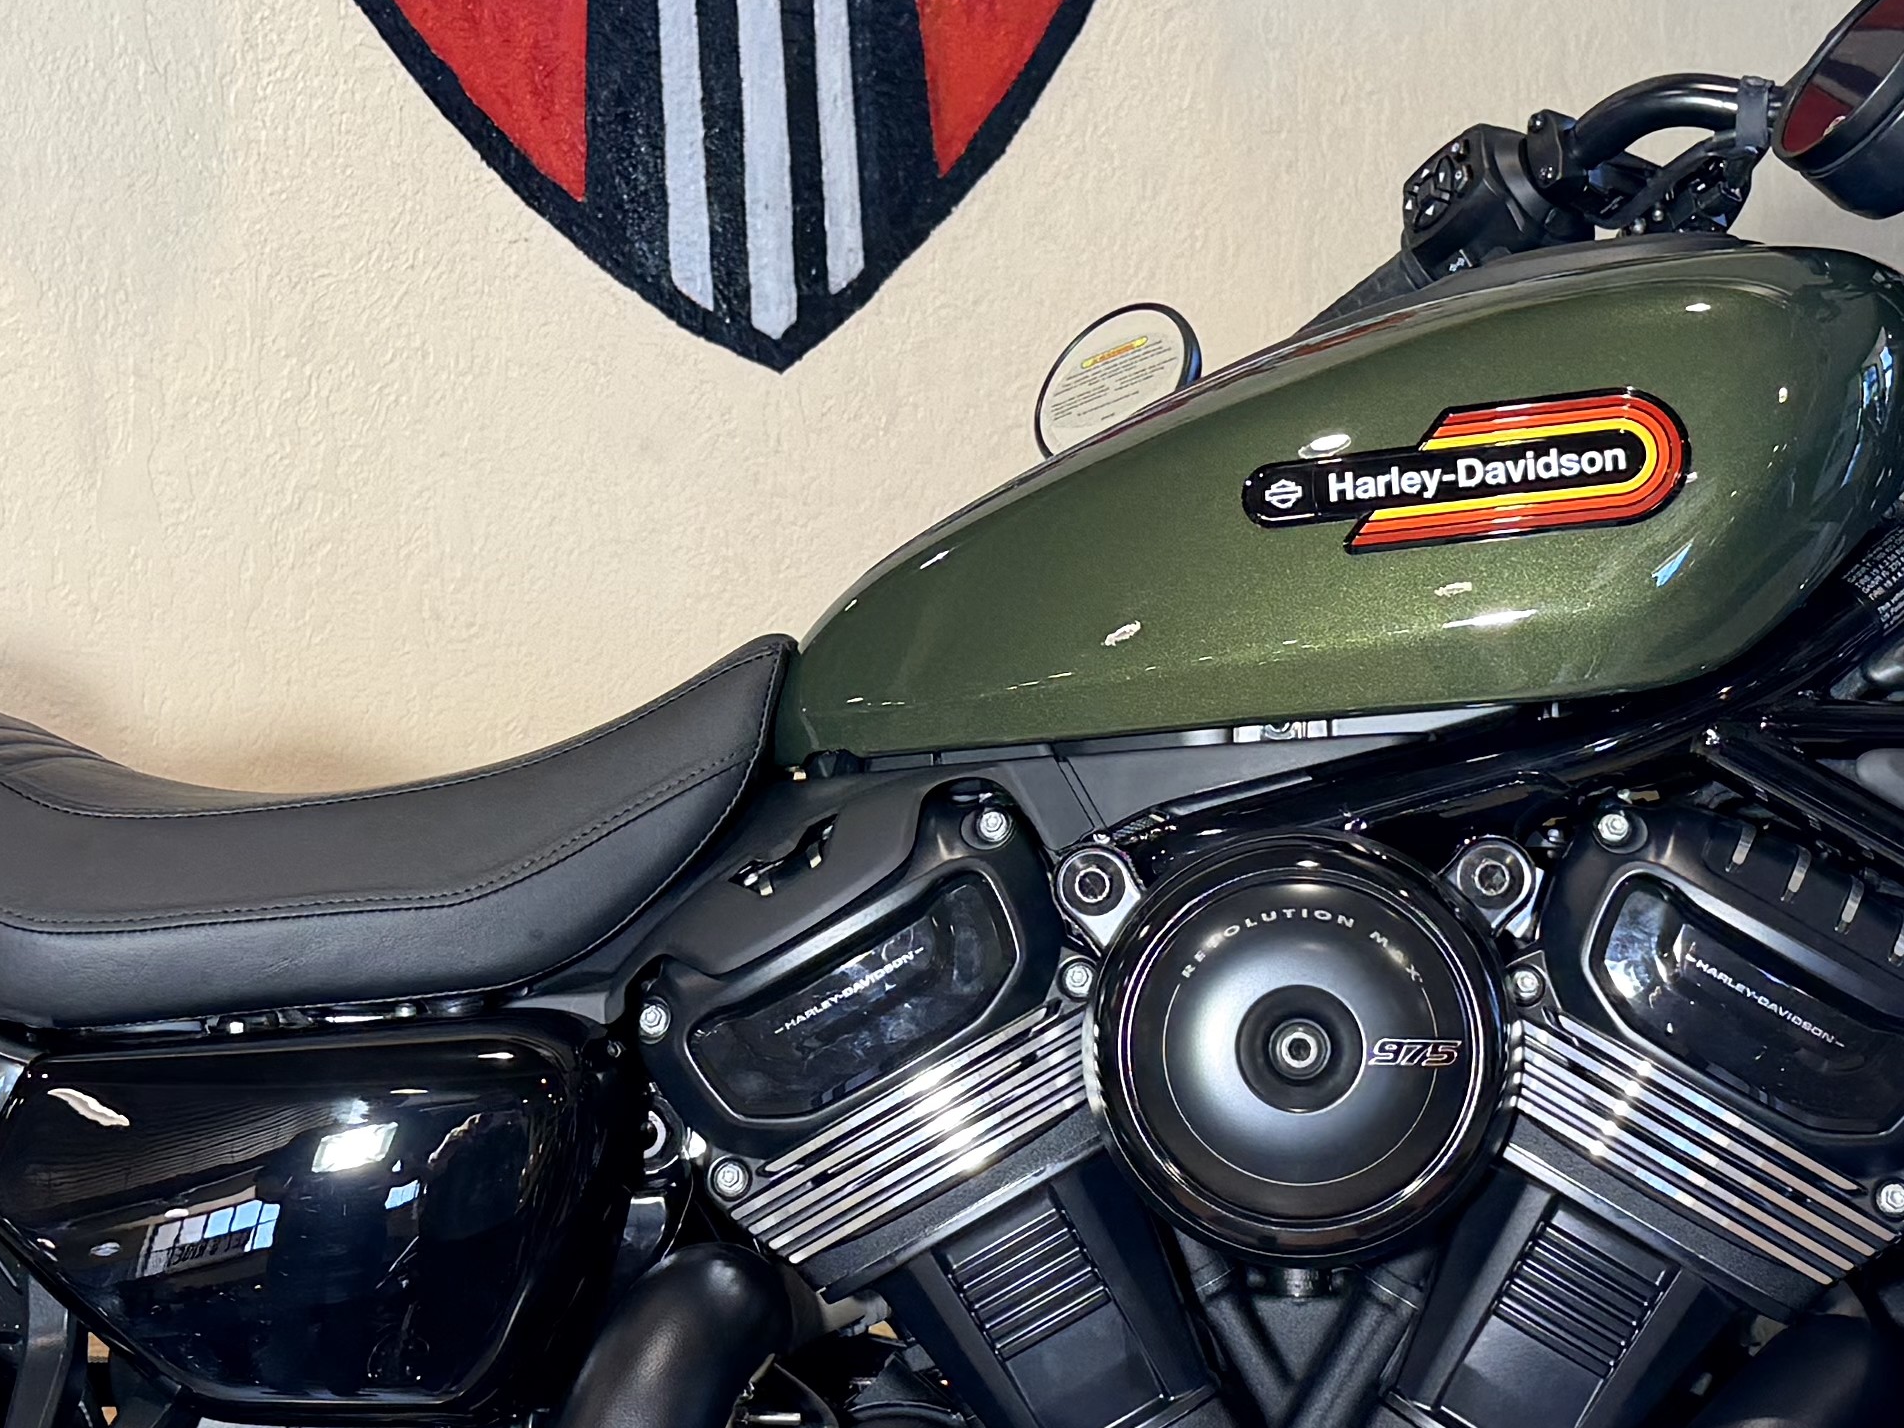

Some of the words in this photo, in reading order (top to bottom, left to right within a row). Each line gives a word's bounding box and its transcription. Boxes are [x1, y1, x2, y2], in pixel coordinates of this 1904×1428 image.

[1327, 446, 1628, 504] Harley-Davidson
[1180, 907, 1356, 979] REVOLUTION
[1369, 930, 1422, 983] MAX
[784, 950, 914, 1031] HARLEY-DAVIDSON
[1695, 959, 1835, 1044] HARLEY-DAVIDSON
[1367, 1037, 1463, 1067] 975
